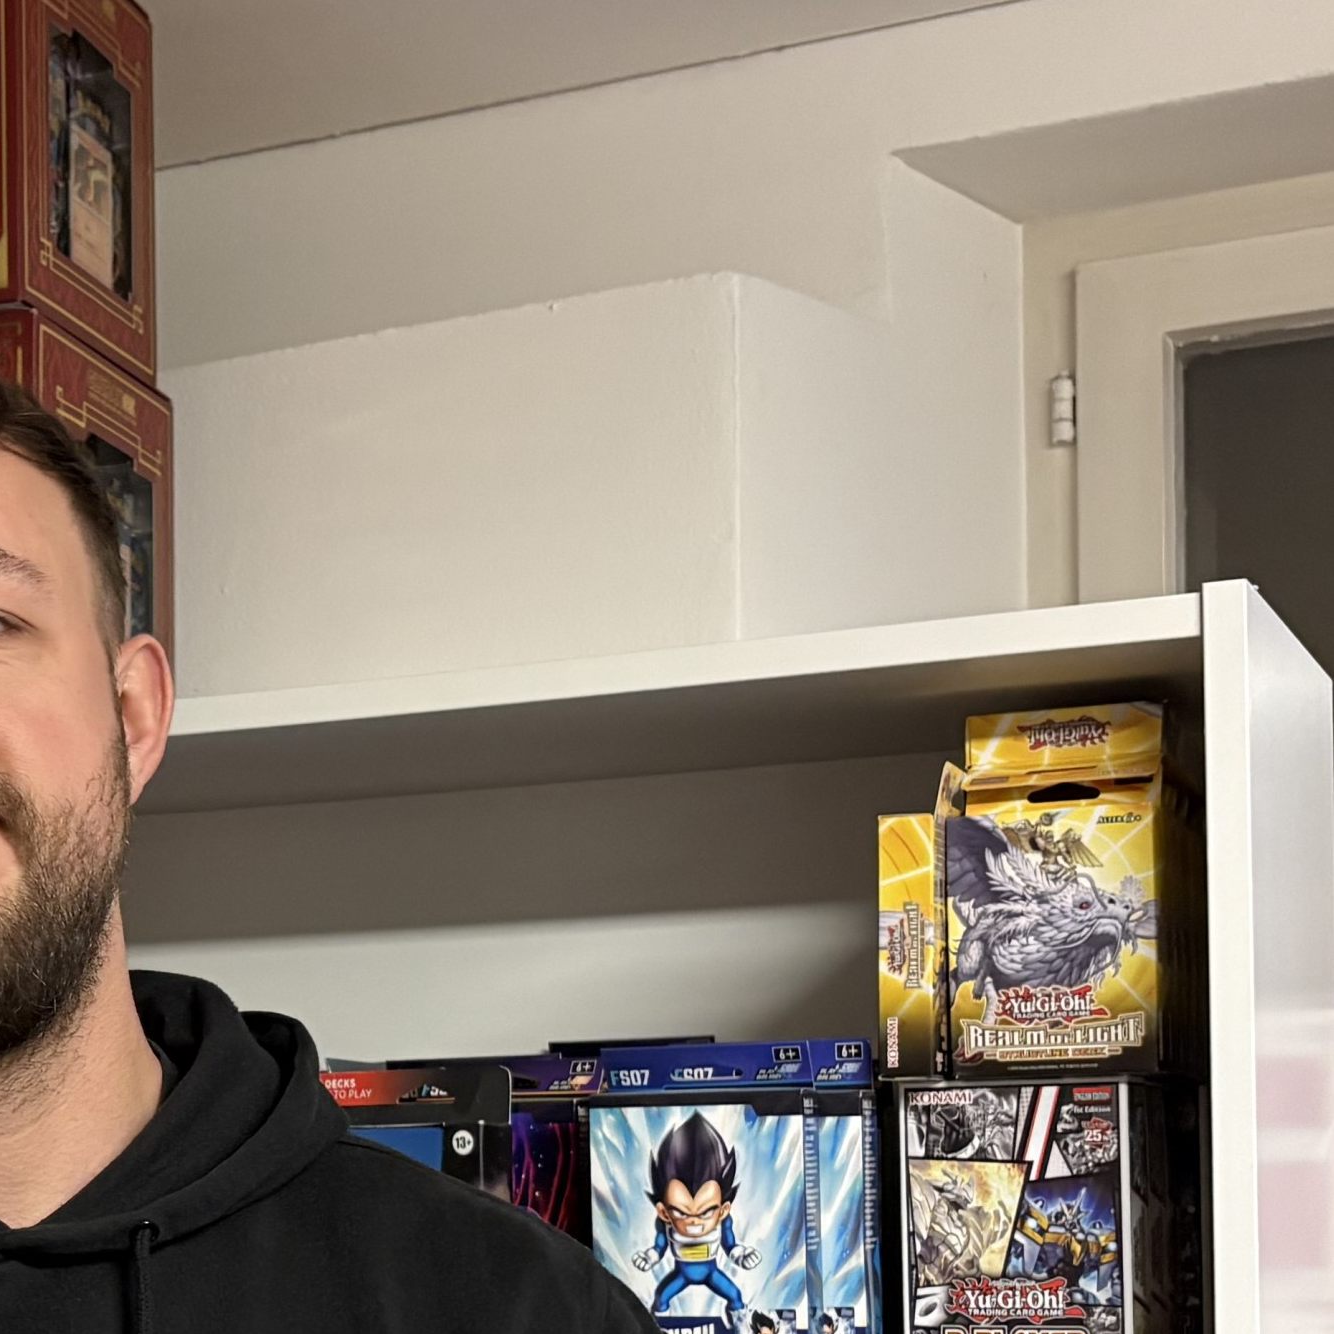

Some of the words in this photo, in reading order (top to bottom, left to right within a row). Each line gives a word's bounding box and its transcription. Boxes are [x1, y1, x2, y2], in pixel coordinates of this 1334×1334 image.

[969, 1025, 1044, 1050] REALM
[1074, 1016, 1142, 1045] LIGHT
[887, 1016, 899, 1068] KONAMI
[779, 1049, 796, 1061] 6+
[841, 1046, 859, 1059] 6+
[577, 1060, 593, 1074] 6+
[610, 1069, 650, 1087] FS07
[334, 1088, 347, 1100] TO
[348, 1089, 372, 1102] PLAY
[909, 1090, 973, 1105] KONAMI
[455, 1135, 472, 1150] 13+
[965, 1288, 1064, 1310] Yu-Gi-Oh!
[968, 1308, 1008, 1317] TRADING
[1010, 1309, 1035, 1317] CARD
[1037, 1308, 1064, 1316] GAME
